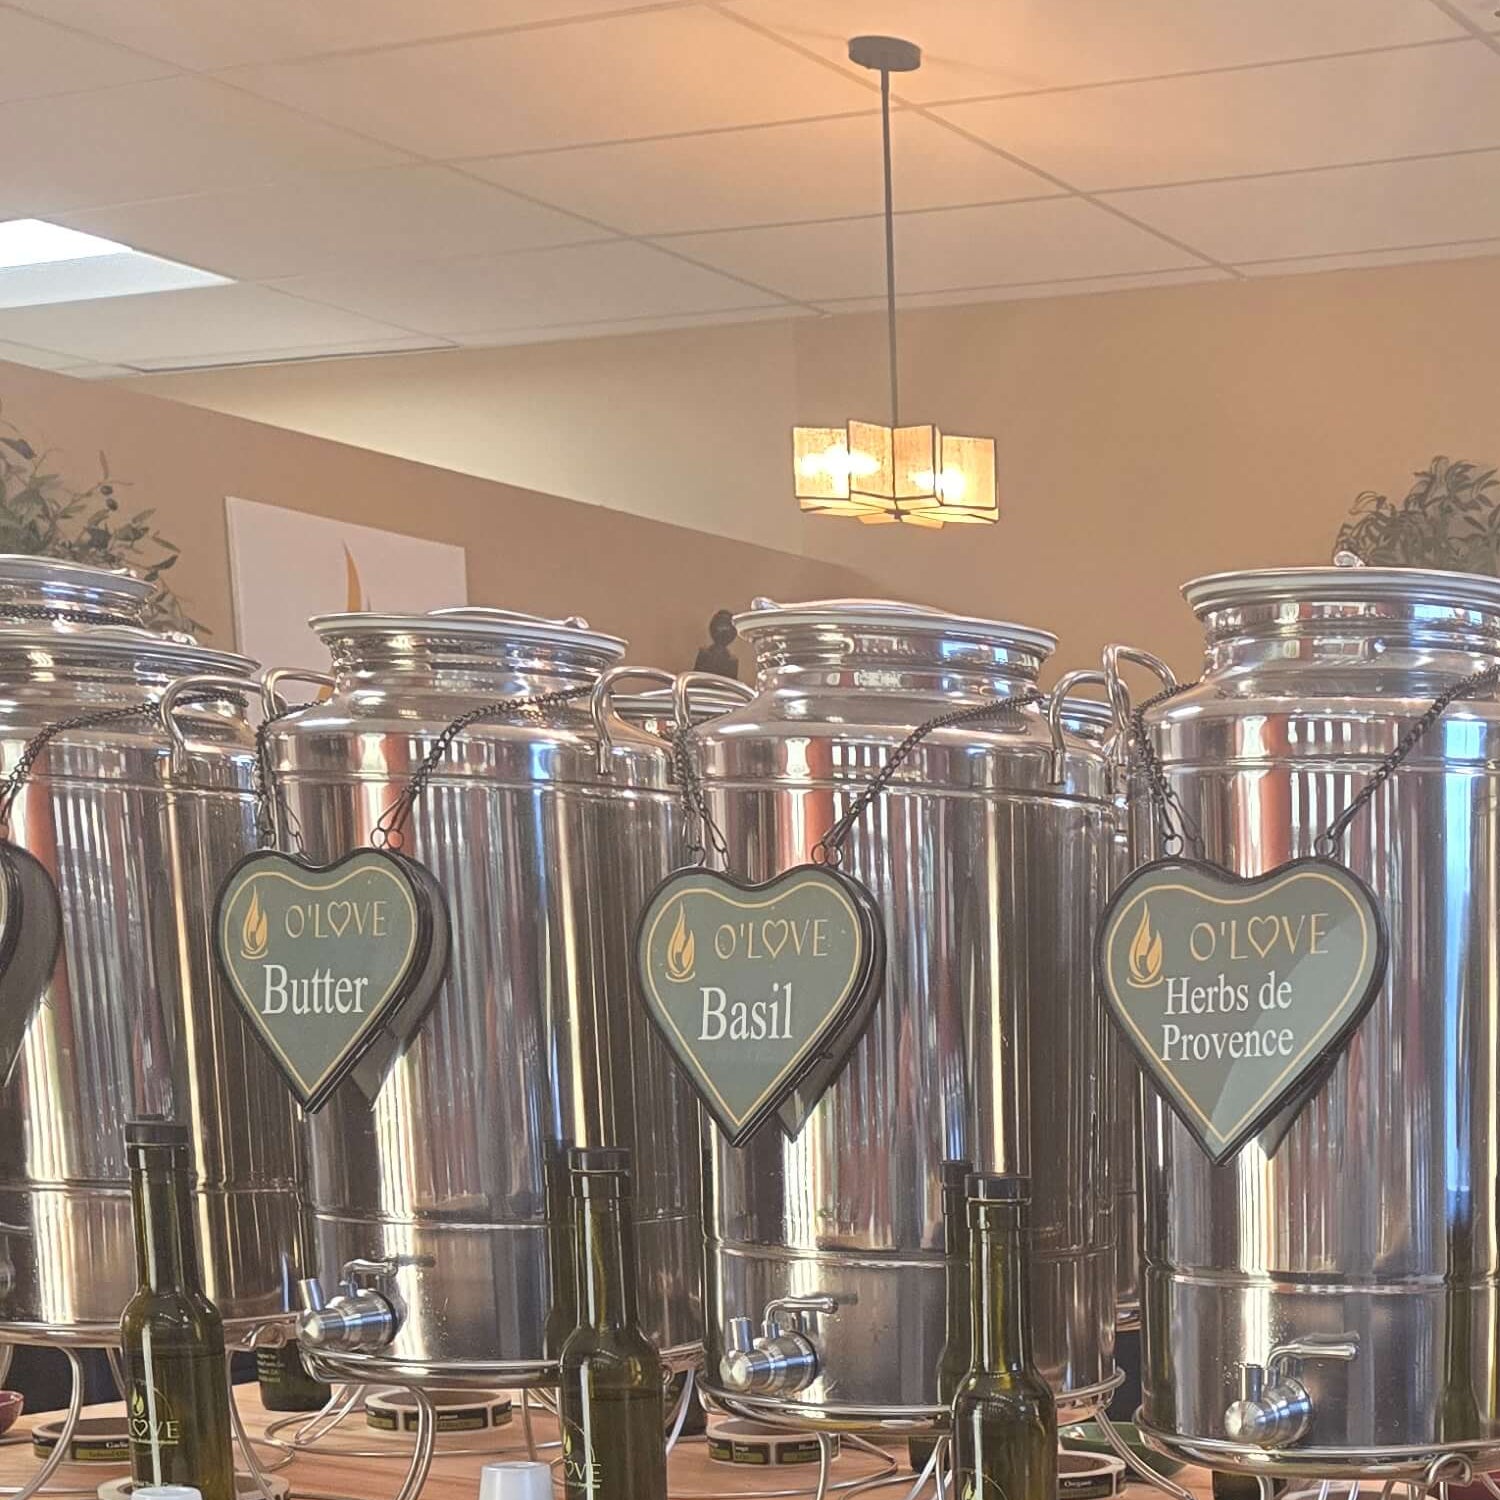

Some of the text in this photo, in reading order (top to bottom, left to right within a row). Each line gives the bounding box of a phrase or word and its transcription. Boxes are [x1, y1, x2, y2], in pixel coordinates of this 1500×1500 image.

[262, 964, 369, 1014] Butter
[697, 982, 793, 1041] Basil
[1163, 970, 1292, 1015] Herbs de
[1160, 1024, 1294, 1061] Provence
